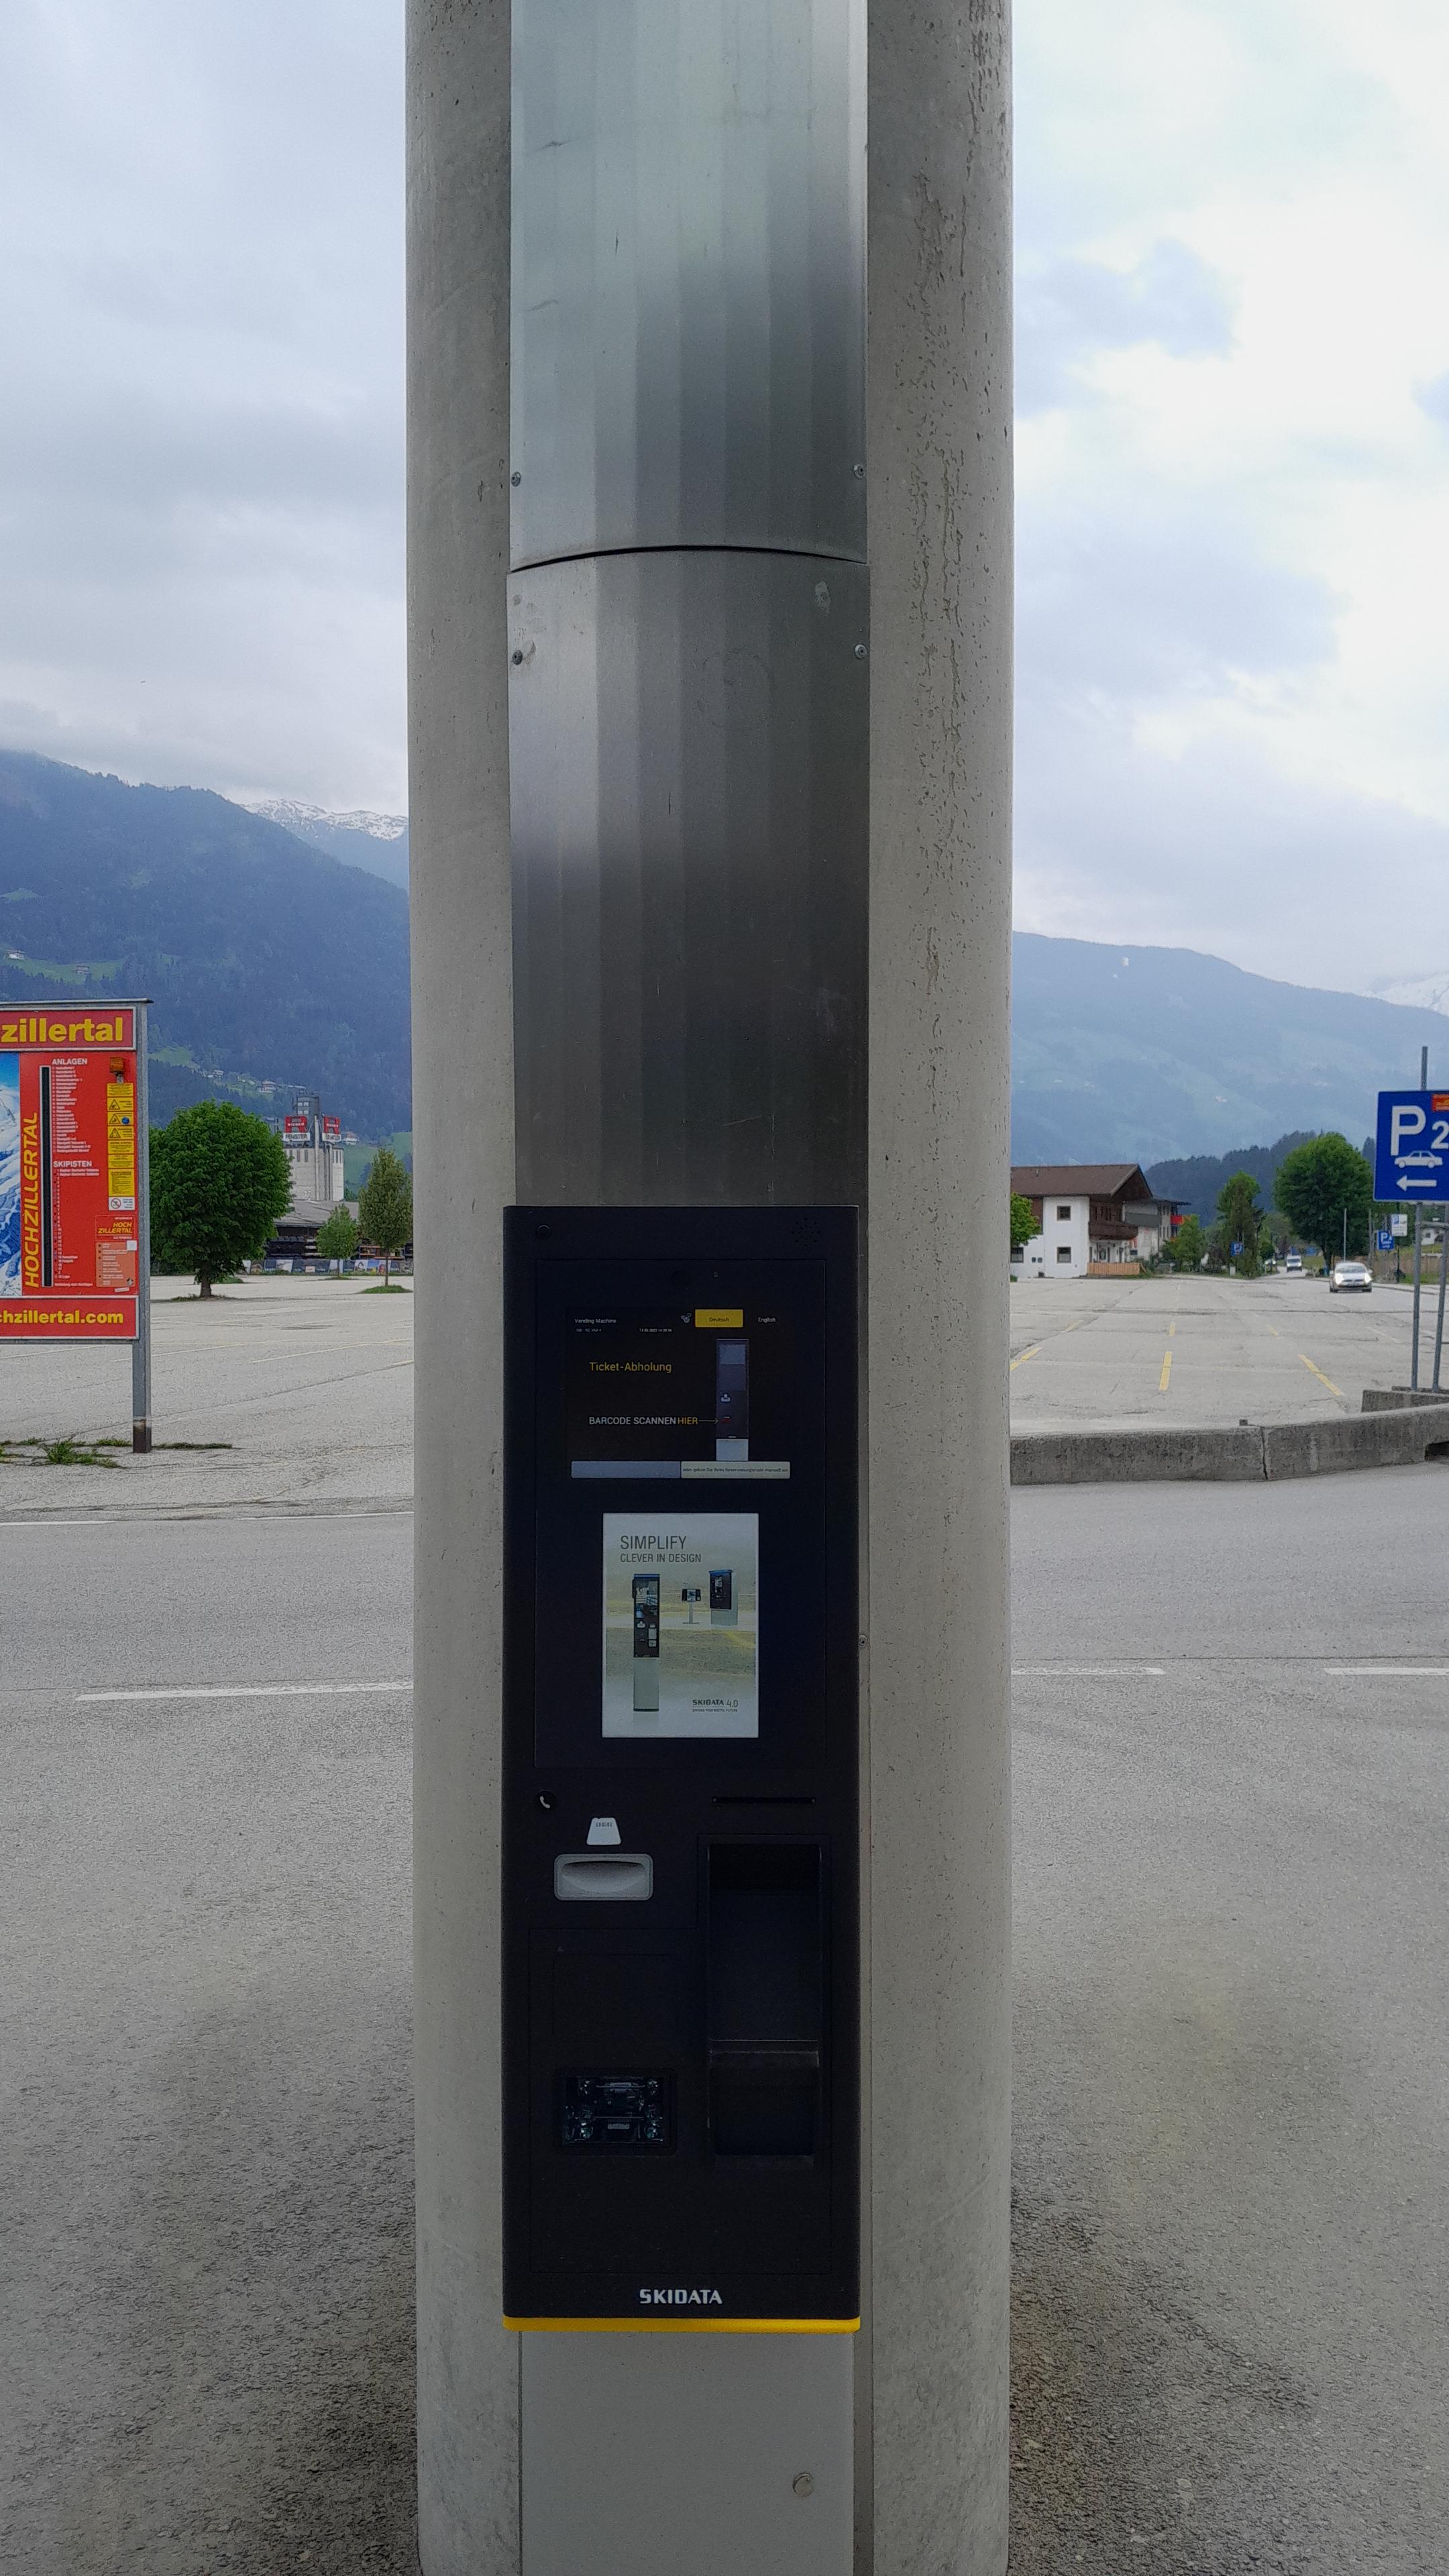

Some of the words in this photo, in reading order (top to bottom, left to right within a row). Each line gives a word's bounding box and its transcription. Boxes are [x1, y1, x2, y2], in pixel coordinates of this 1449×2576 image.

[1, 1017, 123, 1042] zillertal
[1391, 1106, 1426, 1156] P
[1431, 1121, 1449, 1149] 2
[23, 1112, 40, 1288] HOCHZILLERTAL
[0, 1310, 123, 1324] hzillertal.com
[589, 1362, 672, 1374] Ticket-Abholung
[589, 1417, 631, 1425] BARCODE
[633, 1417, 676, 1425] SCANNEN
[678, 1417, 698, 1425] HIER
[620, 1535, 687, 1550] SIMPLIFY
[620, 1553, 653, 1562] CLEVER
[657, 1553, 665, 1562] IN
[669, 1553, 701, 1562] DESIGN
[726, 1699, 738, 1708] 4.0
[639, 2289, 723, 2304] SKIDATA
